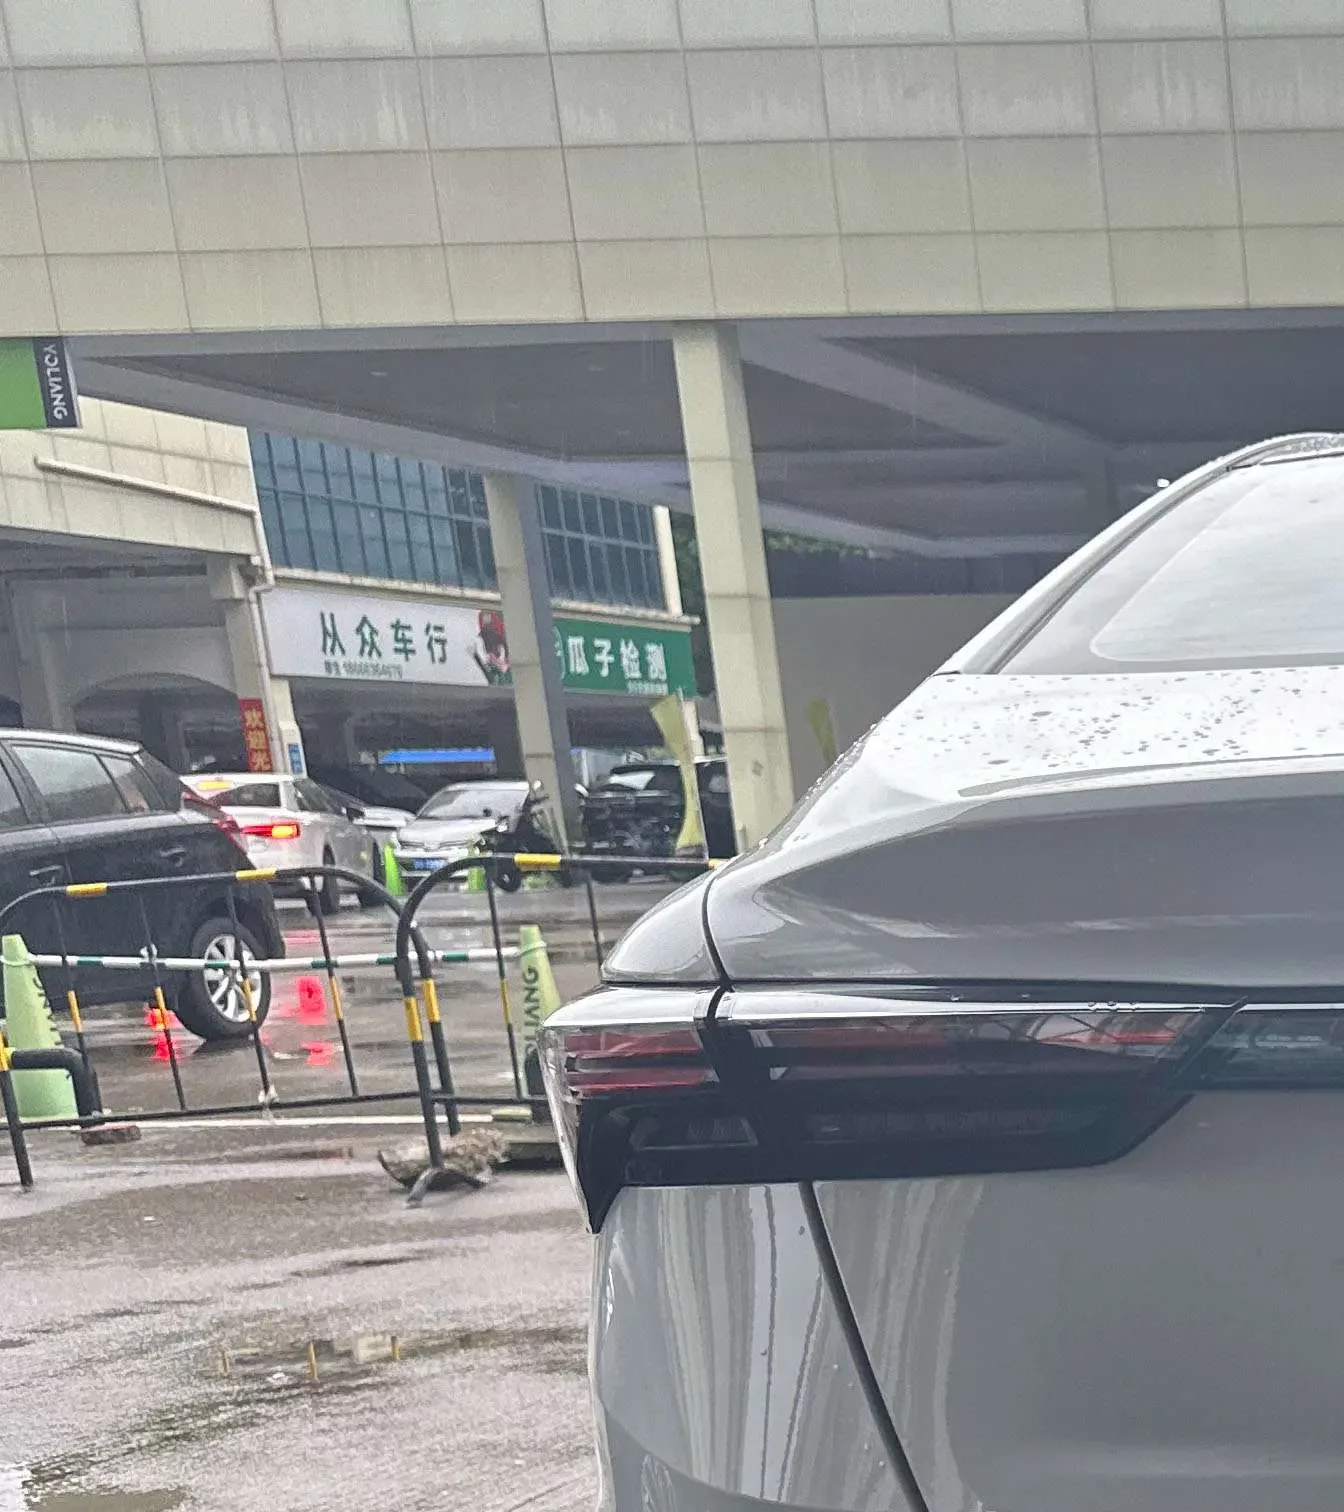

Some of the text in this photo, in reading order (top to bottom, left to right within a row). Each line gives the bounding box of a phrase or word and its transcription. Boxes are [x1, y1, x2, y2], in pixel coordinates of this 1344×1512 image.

[44, 343, 69, 420] YOLIANG
[320, 611, 449, 665] 从众车行
[567, 635, 669, 682] 瓜子检测
